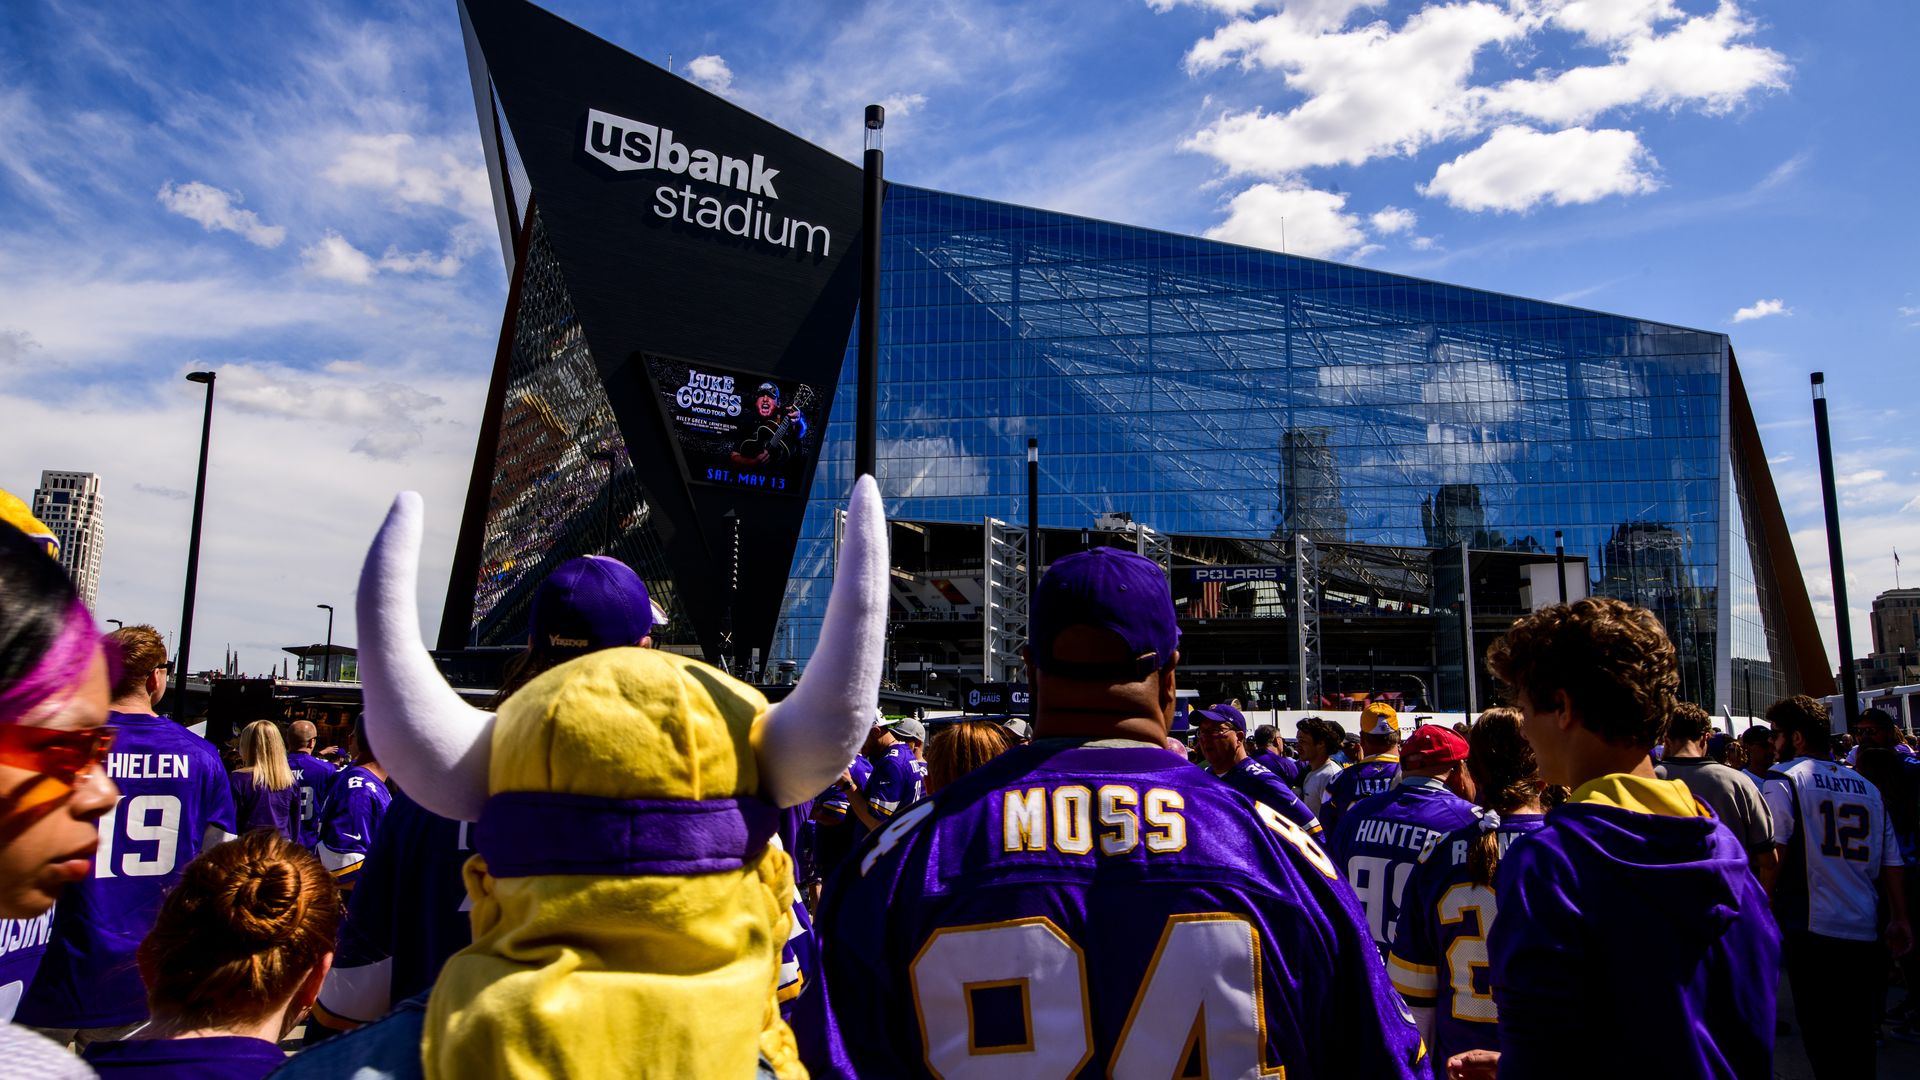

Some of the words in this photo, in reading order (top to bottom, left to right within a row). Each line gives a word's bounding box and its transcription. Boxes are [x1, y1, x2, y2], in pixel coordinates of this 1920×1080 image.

[653, 184, 831, 257] stadium
[688, 369, 735, 394] LUKE
[676, 386, 742, 417] COMBS
[691, 406, 711, 415] WORLD
[711, 409, 726, 417] TOUR
[707, 468, 733, 482] SAT.
[738, 472, 765, 487] MAY
[771, 477, 785, 489] 13
[1196, 568, 1277, 580] POLARIS
[981, 694, 1001, 703] HAUS
[106, 753, 189, 778] HIELEN
[1812, 773, 1868, 795] HARVIN
[1003, 784, 1187, 857] MOSS
[1819, 800, 1870, 862] 12
[95, 795, 182, 878] 19
